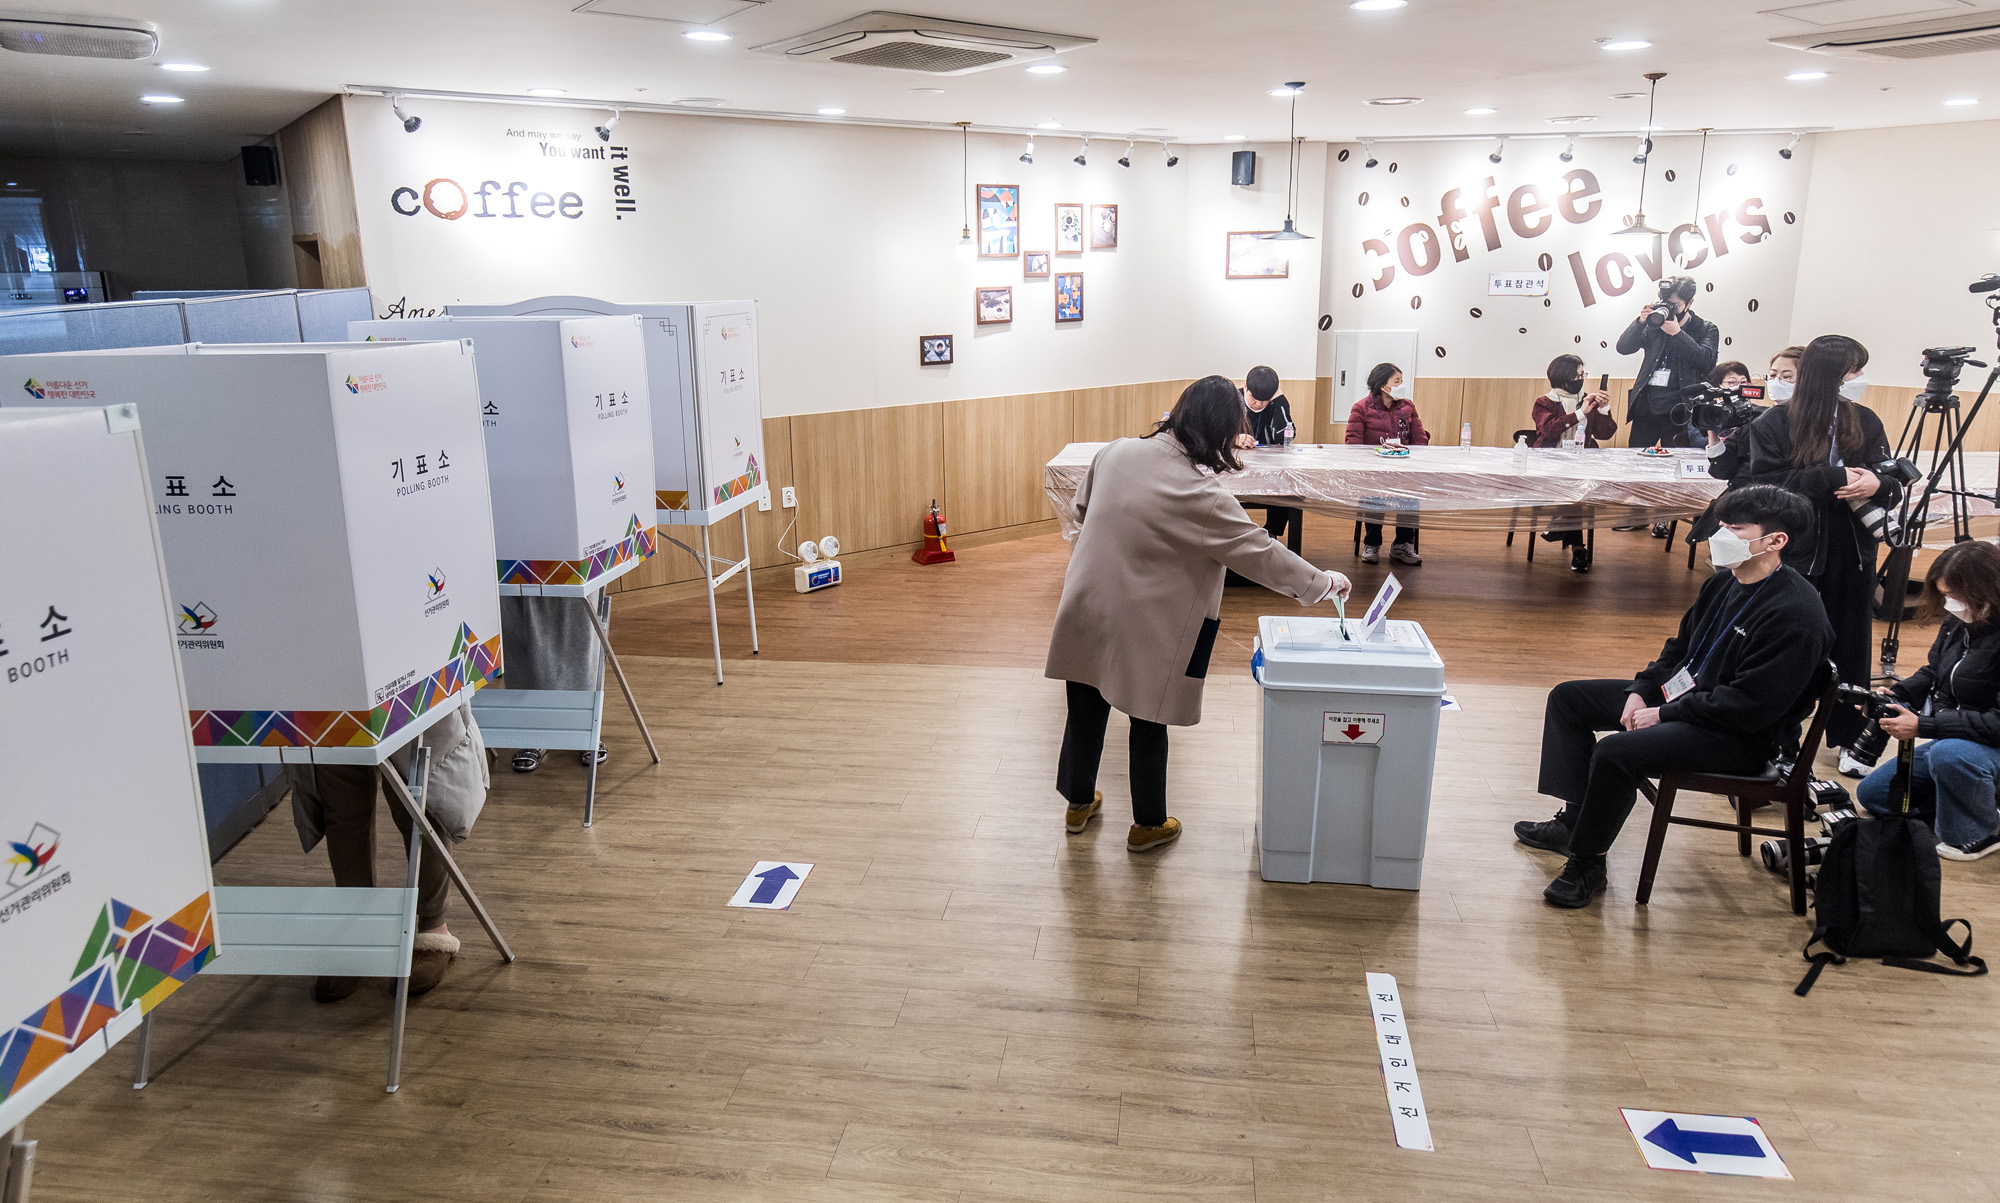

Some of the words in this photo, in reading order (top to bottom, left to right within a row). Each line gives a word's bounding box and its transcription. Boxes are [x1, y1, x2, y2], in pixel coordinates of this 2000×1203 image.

[506, 128, 525, 138] And
[527, 130, 548, 142] may
[539, 142, 567, 158] You
[571, 146, 606, 160] want
[610, 146, 629, 160] it
[613, 165, 637, 220] well.
[1362, 168, 1603, 293] coffee
[1566, 197, 1772, 309] lovers
[720, 366, 745, 385] 기표소
[595, 391, 629, 411] 기표소
[391, 449, 450, 482] 기표소
[396, 481, 426, 497] POLLING
[427, 475, 450, 489] BOOTH
[155, 504, 181, 515] ING
[187, 504, 233, 515] BOOTH
[7, 648, 69, 683] BOOTH
[1375, 993, 1419, 1118] 선거인대기선
